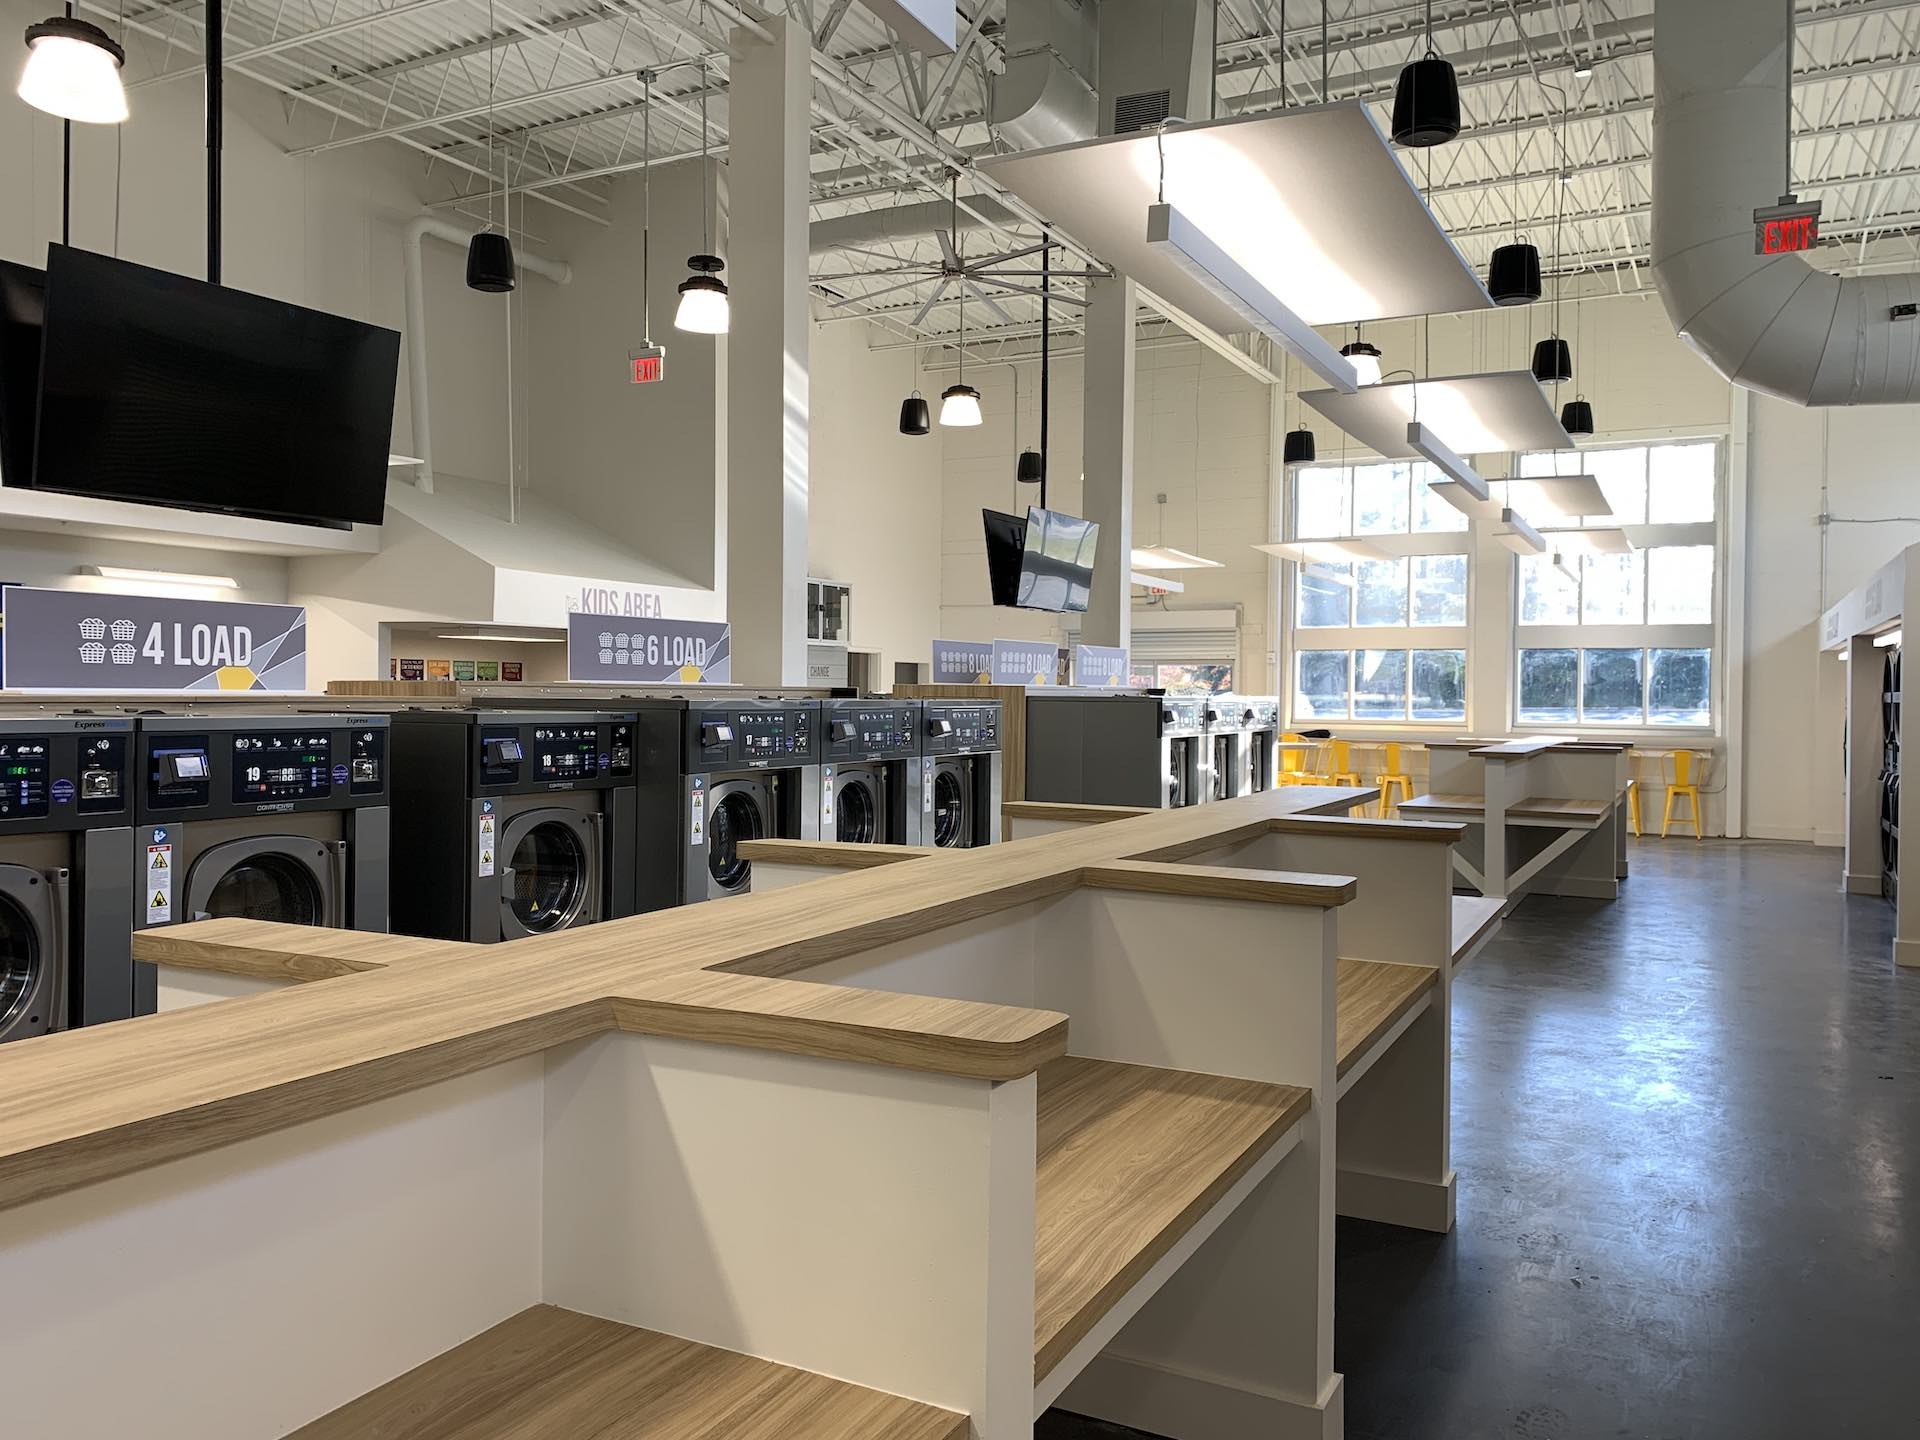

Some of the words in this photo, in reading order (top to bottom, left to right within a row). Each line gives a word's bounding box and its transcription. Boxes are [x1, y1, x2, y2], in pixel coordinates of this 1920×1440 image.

[1764, 217, 1813, 254] EXIT
[636, 359, 657, 382] EXIT
[582, 587, 619, 615] KIDS
[623, 592, 662, 618] AREA
[142, 622, 165, 665] 4
[174, 623, 252, 667] LOAD
[647, 635, 659, 666] 6
[663, 635, 707, 667] LOAD
[810, 666, 830, 677] CHANGE
[968, 653, 975, 673] 8
[1026, 653, 1032, 673] 8
[1033, 654, 1050, 675] LOAD
[542, 755, 552, 766] 18
[246, 767, 260, 781] 19
